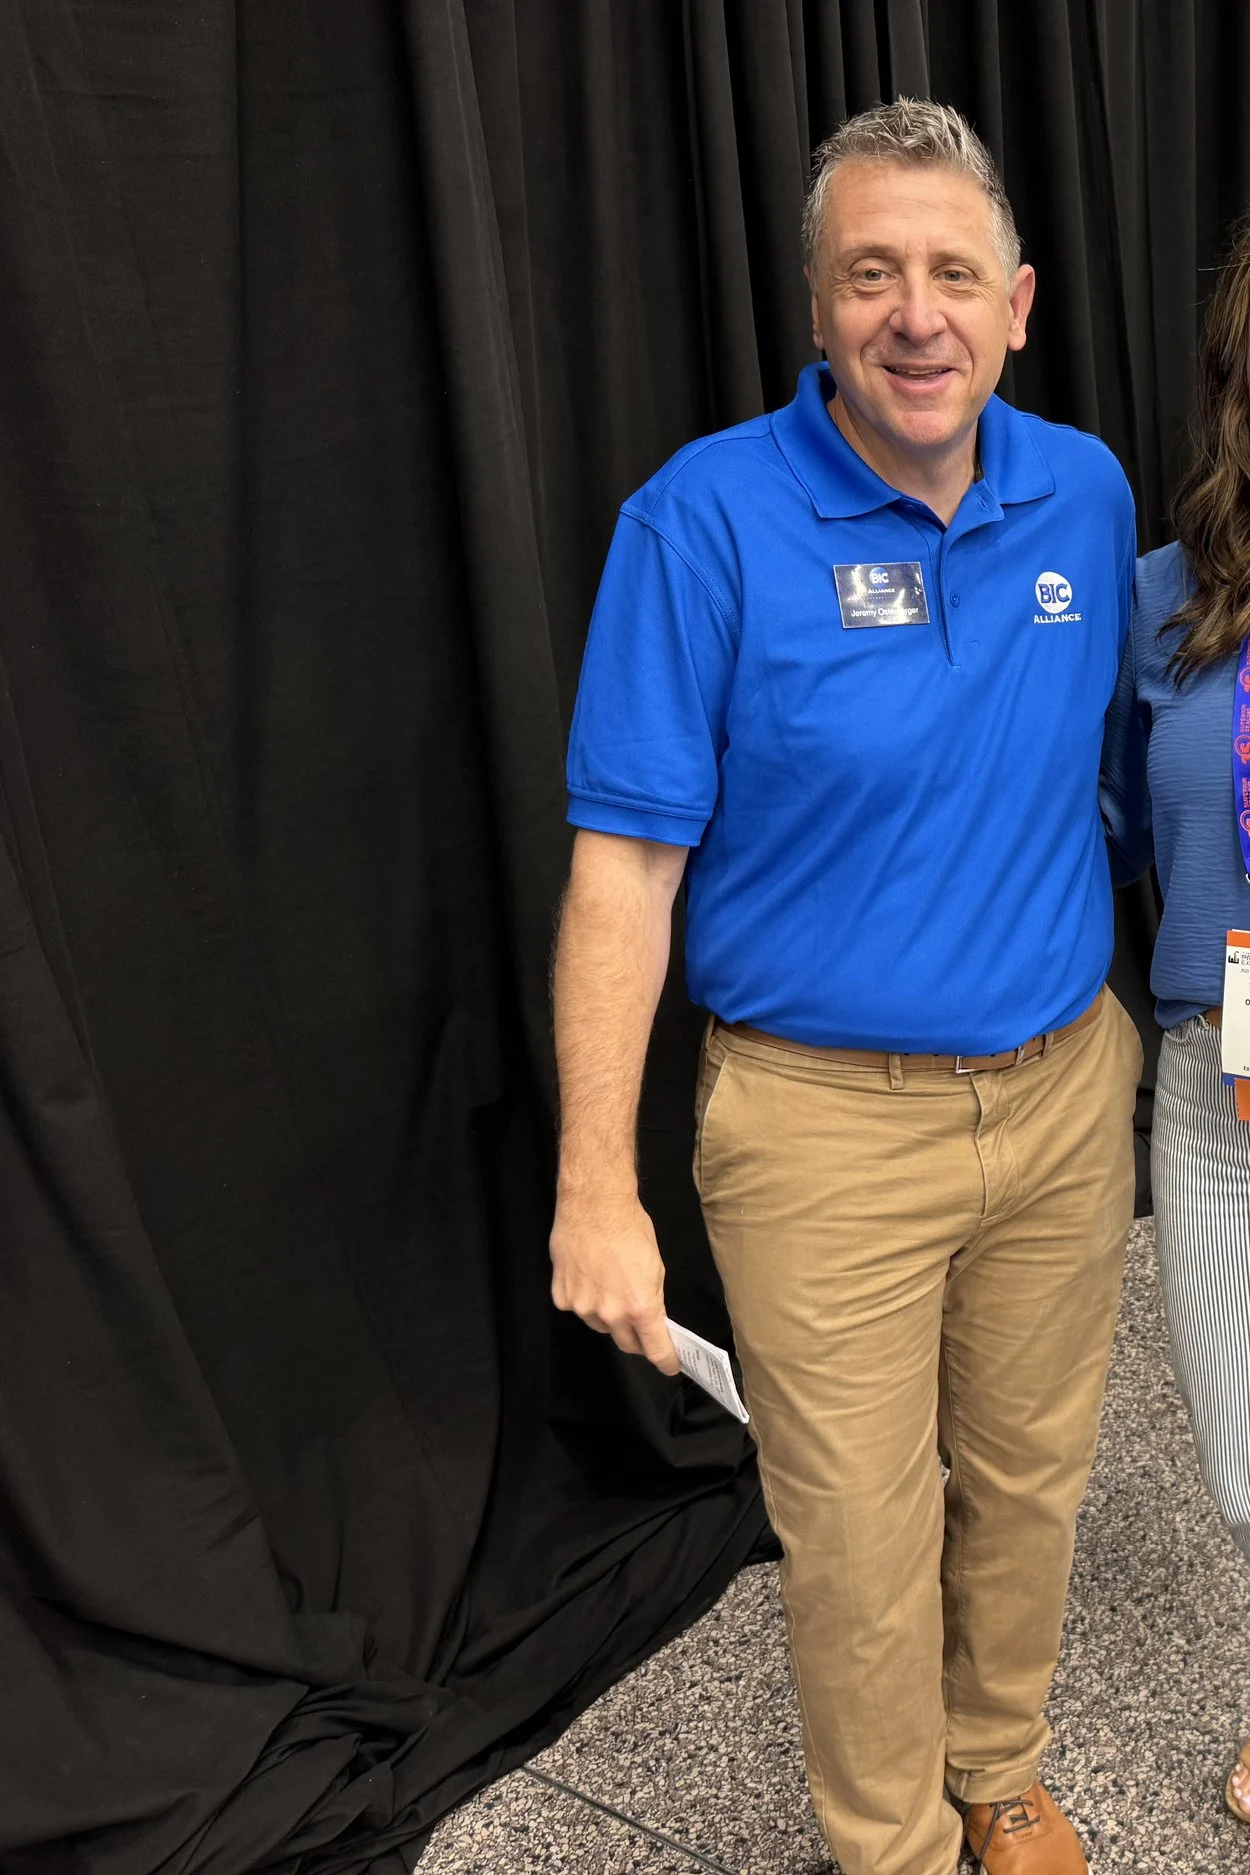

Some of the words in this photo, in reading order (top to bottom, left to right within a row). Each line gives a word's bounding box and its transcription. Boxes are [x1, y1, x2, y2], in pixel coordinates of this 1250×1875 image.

[871, 572, 890, 584] BIC
[1037, 583, 1070, 604] BIC
[851, 609, 877, 618] Jeremy
[1033, 612, 1082, 624] ALLIANCE
[1242, 777, 1250, 809] SUPERIOR
